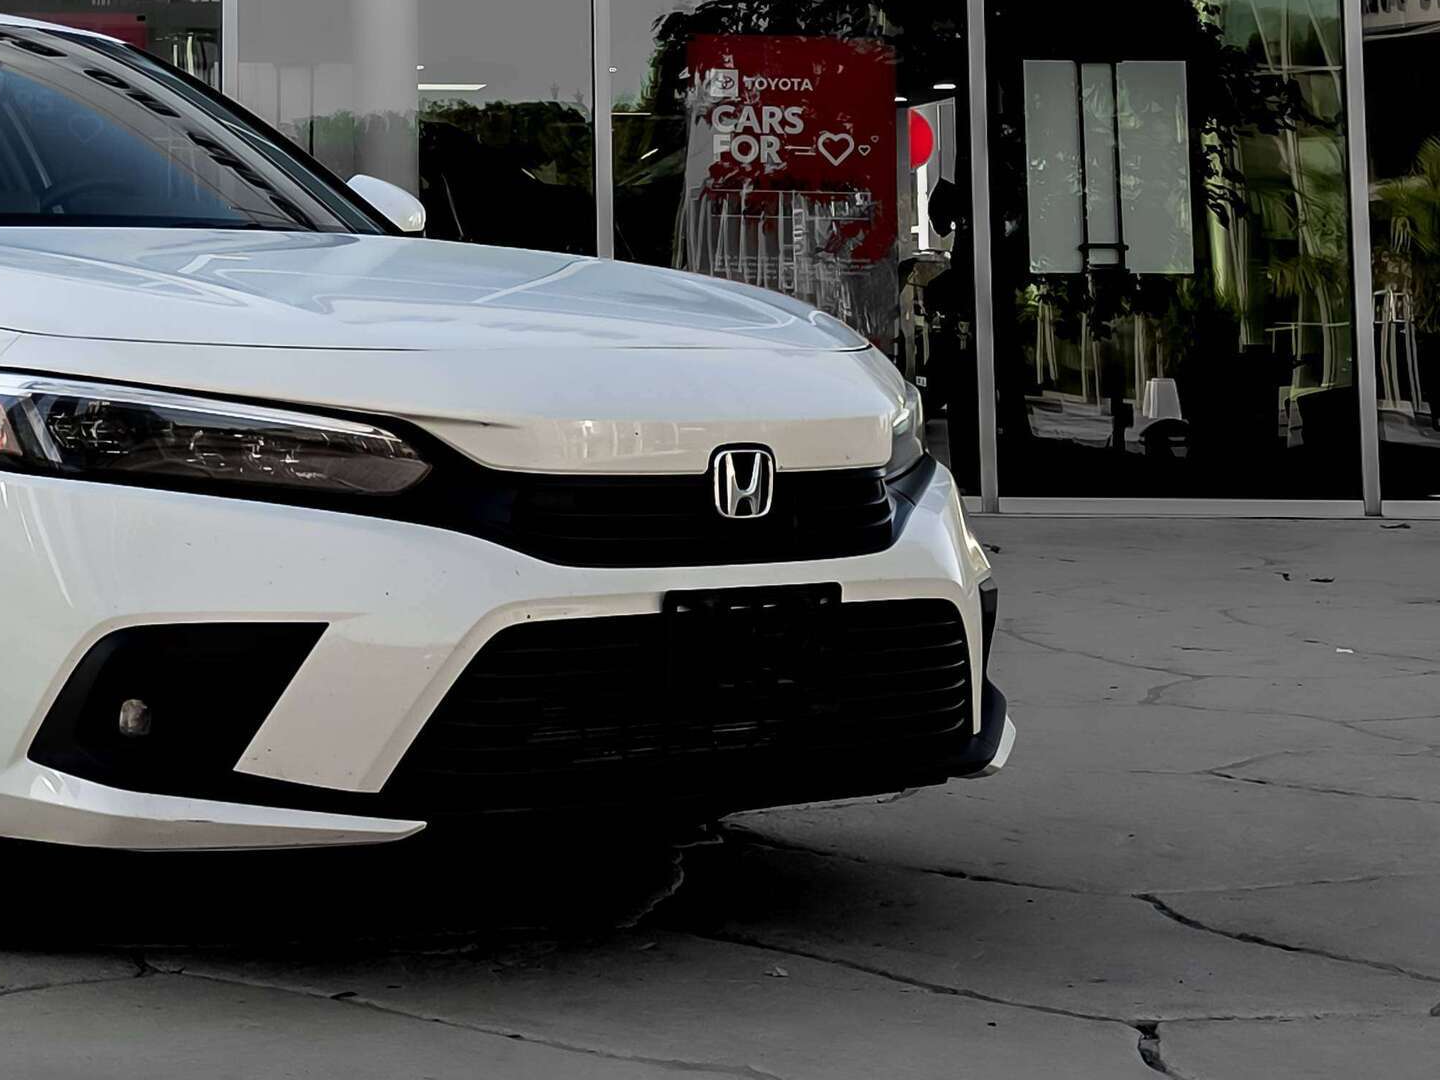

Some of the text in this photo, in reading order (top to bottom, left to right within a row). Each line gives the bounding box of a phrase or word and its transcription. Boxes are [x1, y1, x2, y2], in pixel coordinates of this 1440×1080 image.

[743, 77, 813, 91] TOYOTA
[712, 104, 804, 134] CARS
[713, 134, 782, 164] FOR
